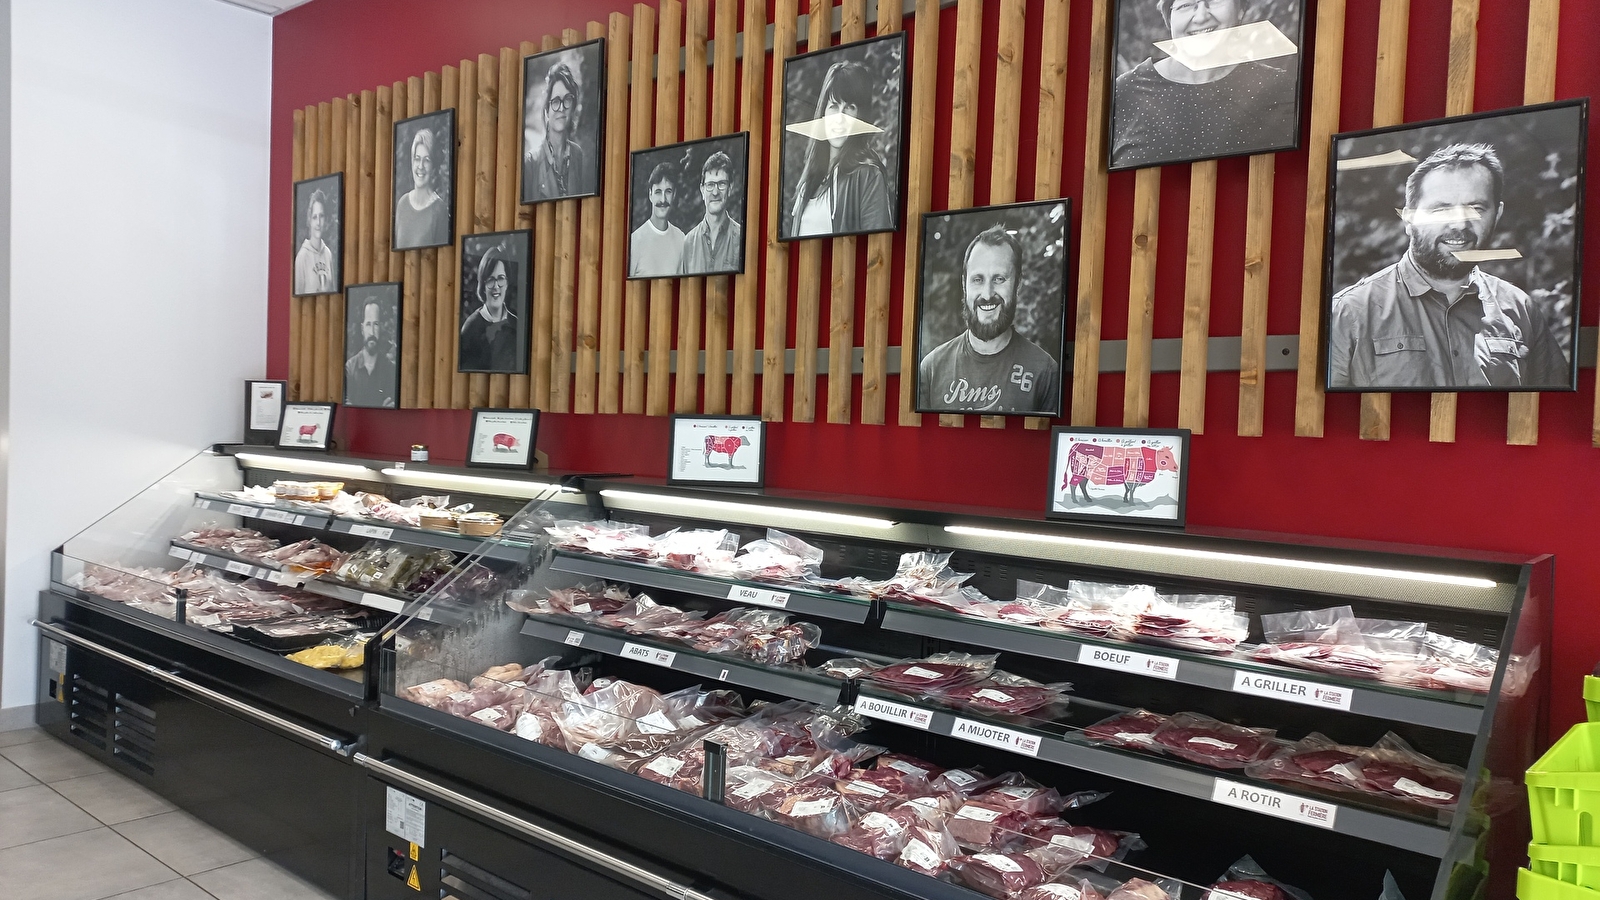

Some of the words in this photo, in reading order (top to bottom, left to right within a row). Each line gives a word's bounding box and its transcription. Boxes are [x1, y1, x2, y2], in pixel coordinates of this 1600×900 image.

[1011, 364, 1034, 392] 26
[944, 377, 1001, 404] Rms
[739, 589, 759, 599] VEAU
[629, 646, 650, 657] ABATS
[1093, 650, 1131, 664] BOEUF
[1241, 676, 1250, 686] A
[1254, 678, 1307, 696] GRILLER
[860, 700, 867, 709] A
[868, 702, 908, 718] BOUILLIR
[958, 723, 966, 732] A
[967, 725, 1010, 743] MIJOTER
[1228, 787, 1237, 798] A
[1240, 789, 1282, 808] ROTIR
